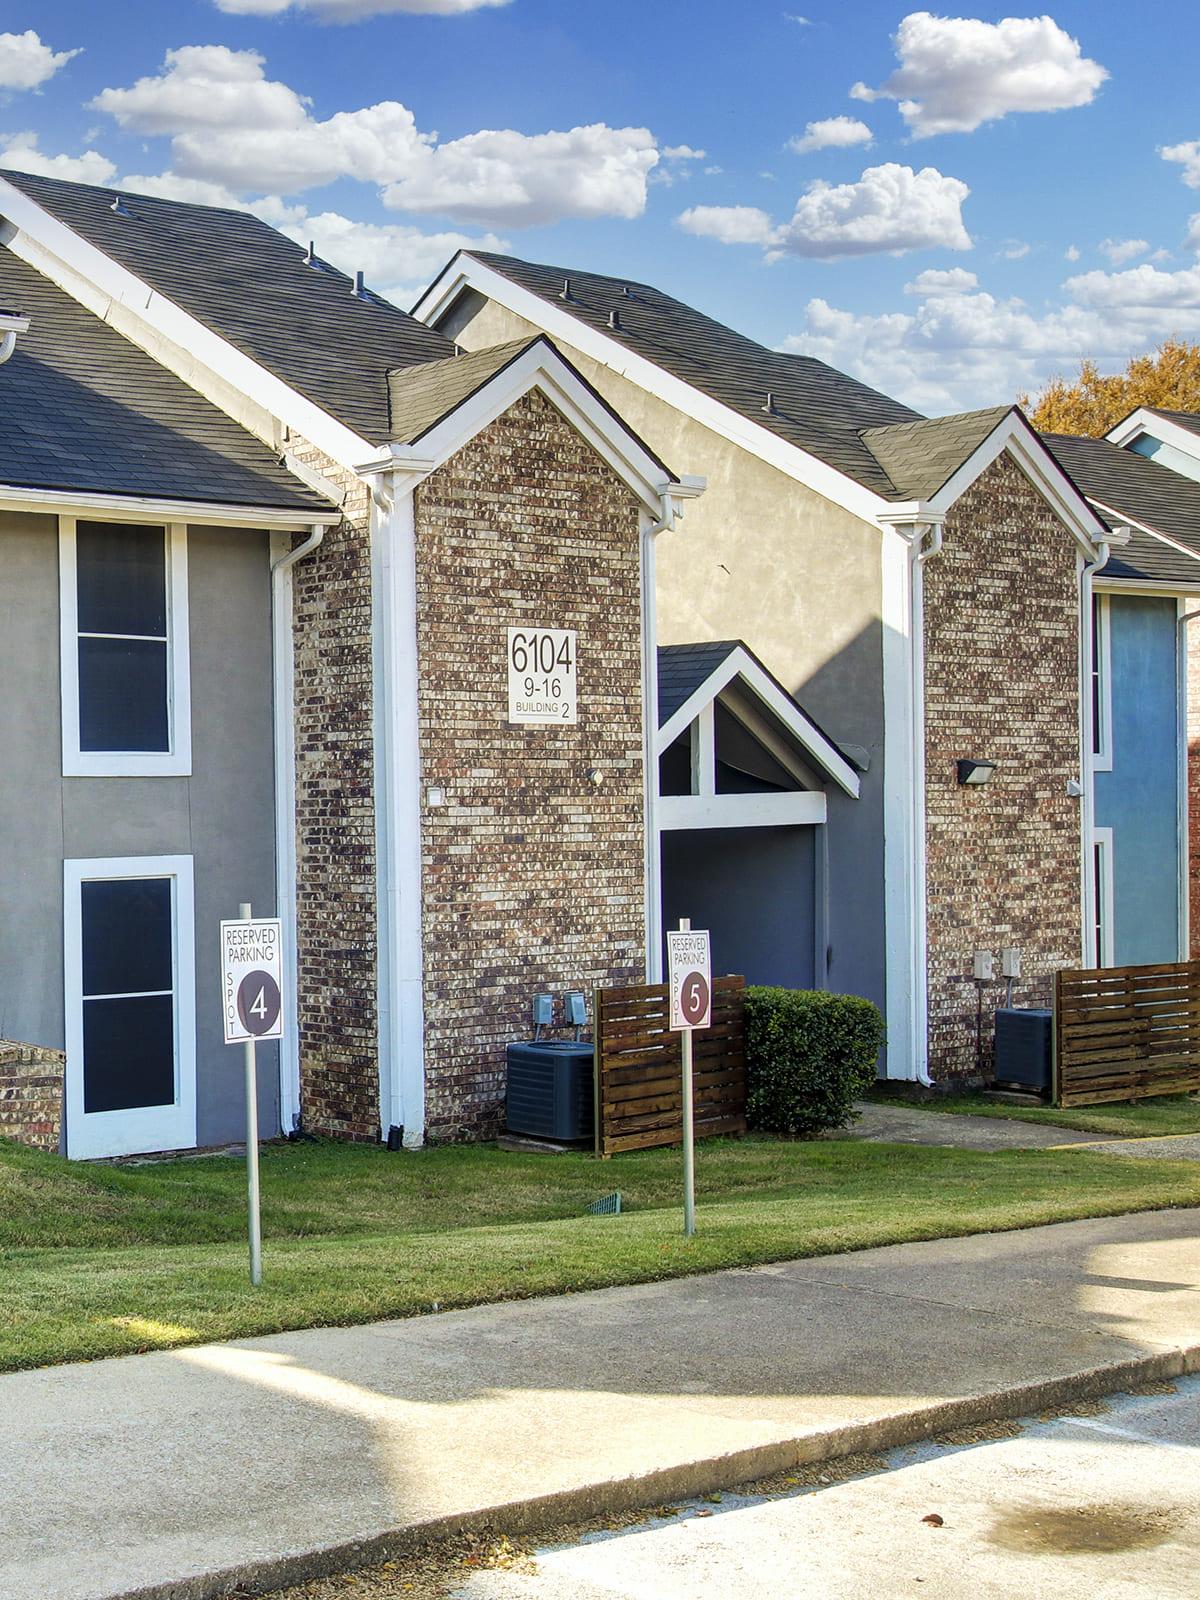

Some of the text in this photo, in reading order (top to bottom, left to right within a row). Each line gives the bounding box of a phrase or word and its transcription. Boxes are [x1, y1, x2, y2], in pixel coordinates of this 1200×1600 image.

[512, 633, 572, 674] 6104
[524, 677, 561, 698] 9-16
[516, 701, 569, 718] BUILDING 2
[226, 928, 275, 945] RESERVED
[672, 937, 706, 951] RESERVED
[228, 945, 274, 962] PARKING
[674, 951, 705, 965] PARKING
[226, 972, 236, 1035] SPOT
[249, 985, 268, 1019] 4
[689, 983, 700, 1012] 5
